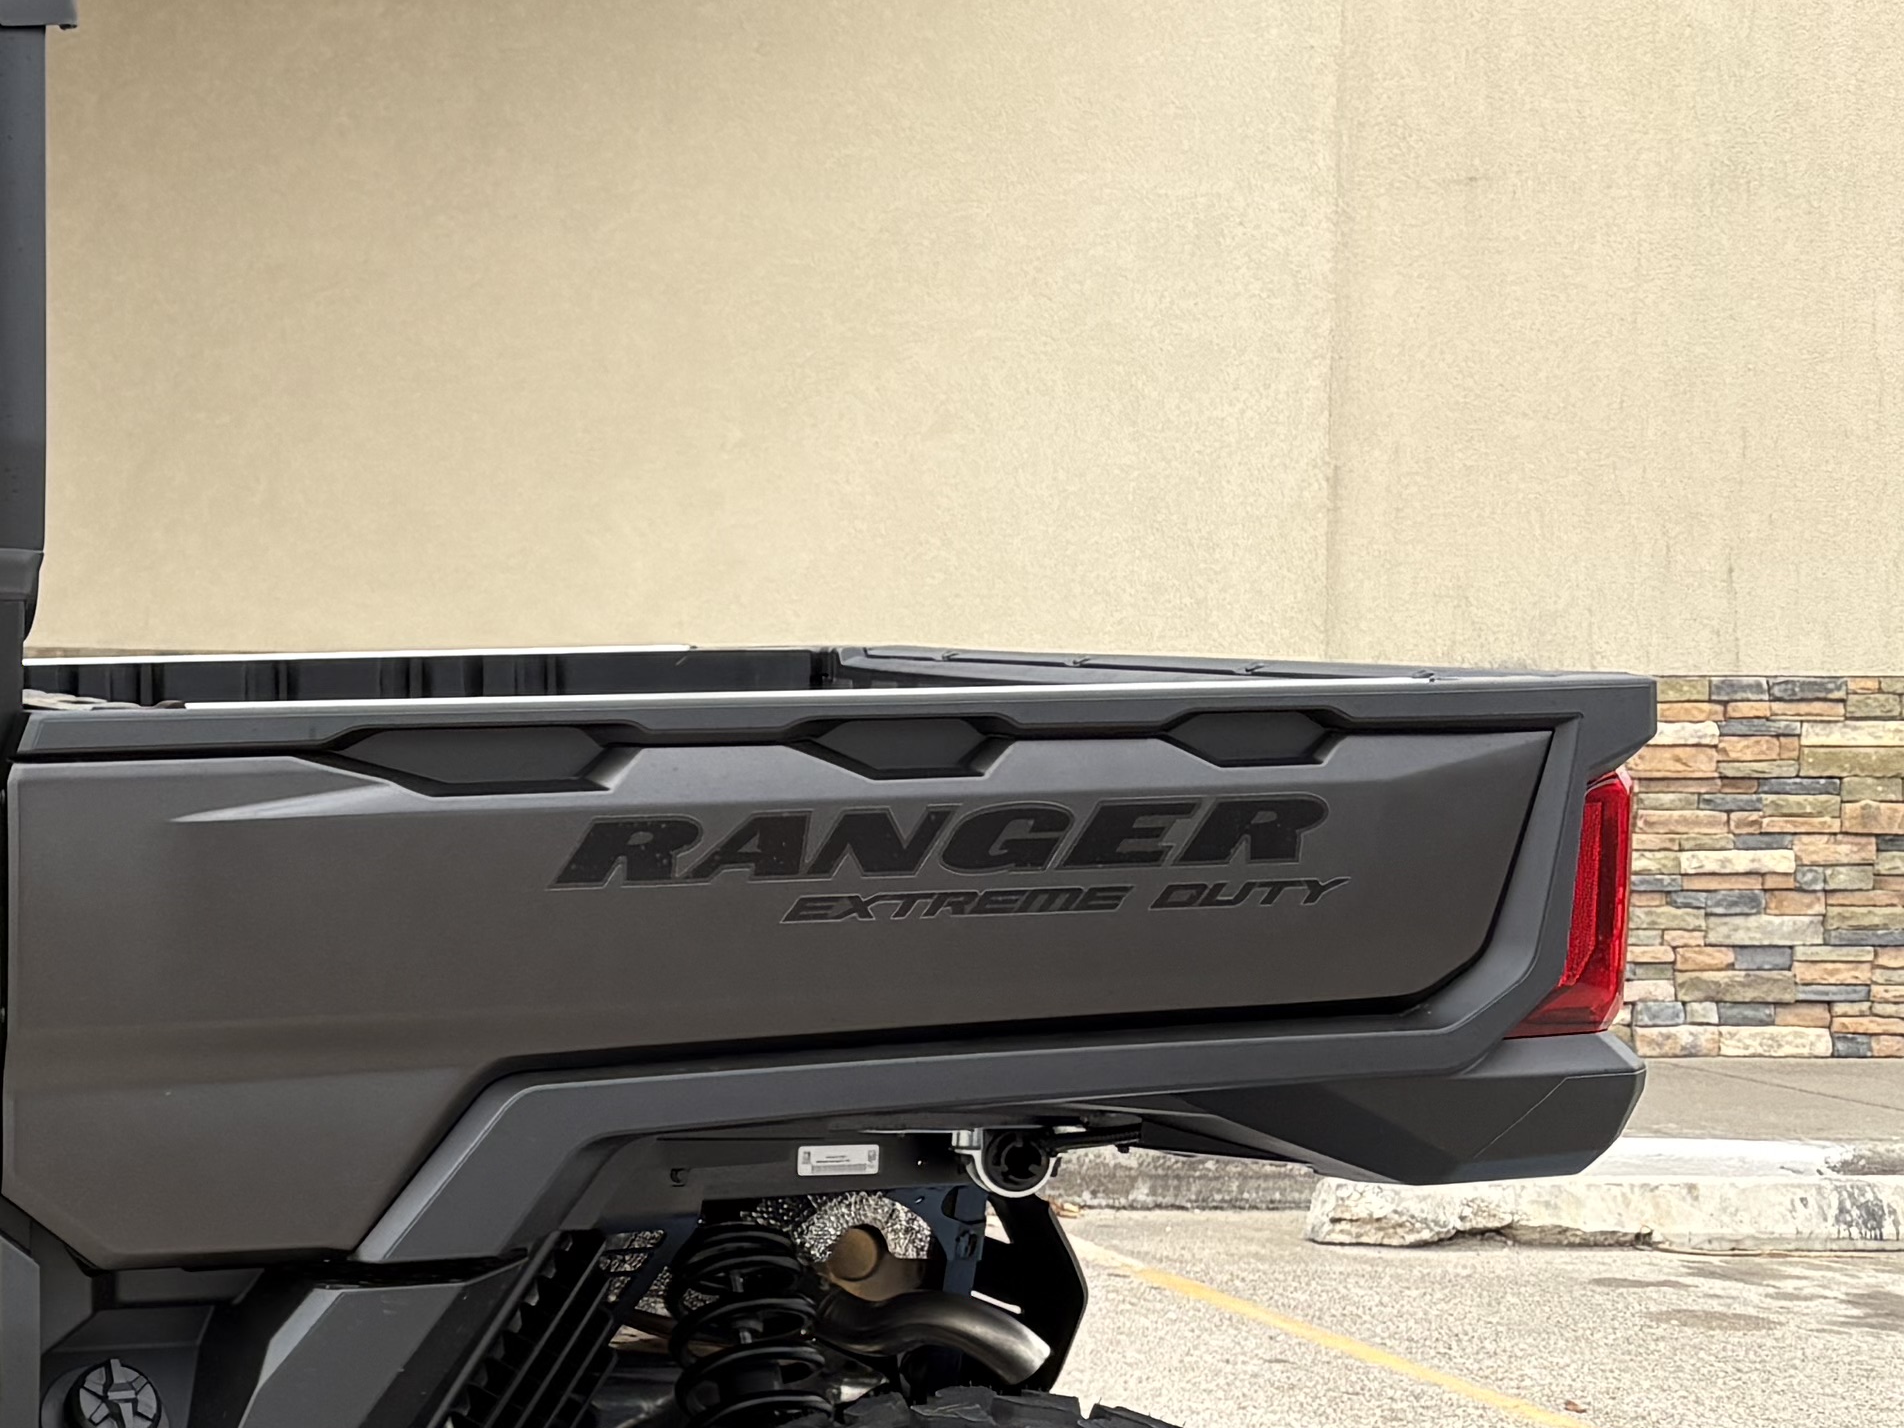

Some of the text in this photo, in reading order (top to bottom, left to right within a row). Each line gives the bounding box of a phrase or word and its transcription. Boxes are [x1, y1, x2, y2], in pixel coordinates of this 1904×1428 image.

[545, 792, 1330, 891] RANGER
[779, 876, 1352, 924] EXTREME DUTY
